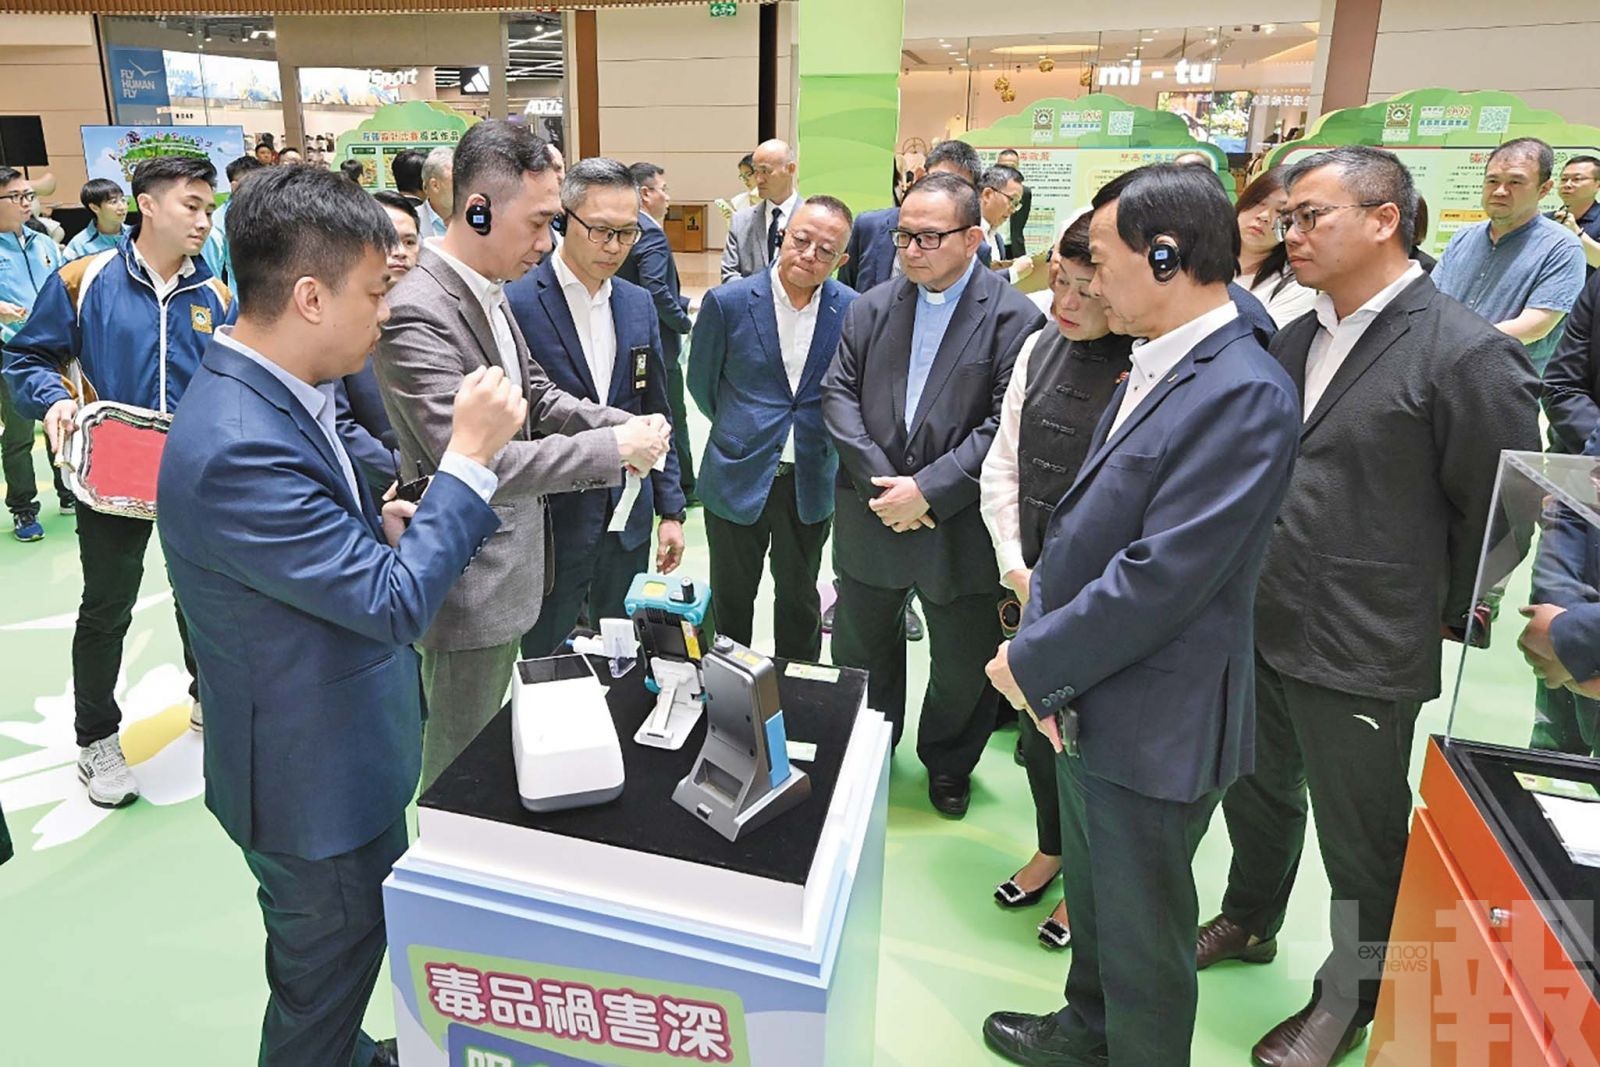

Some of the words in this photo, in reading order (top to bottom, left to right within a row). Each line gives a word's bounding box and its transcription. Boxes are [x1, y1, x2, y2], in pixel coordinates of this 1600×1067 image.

[120, 69, 135, 79] FLY
[1098, 60, 1141, 85] mi
[1174, 58, 1212, 84] tu
[121, 80, 155, 89] HUMAN
[123, 88, 138, 98] FLY
[427, 965, 730, 1061] 毒品禍害深
